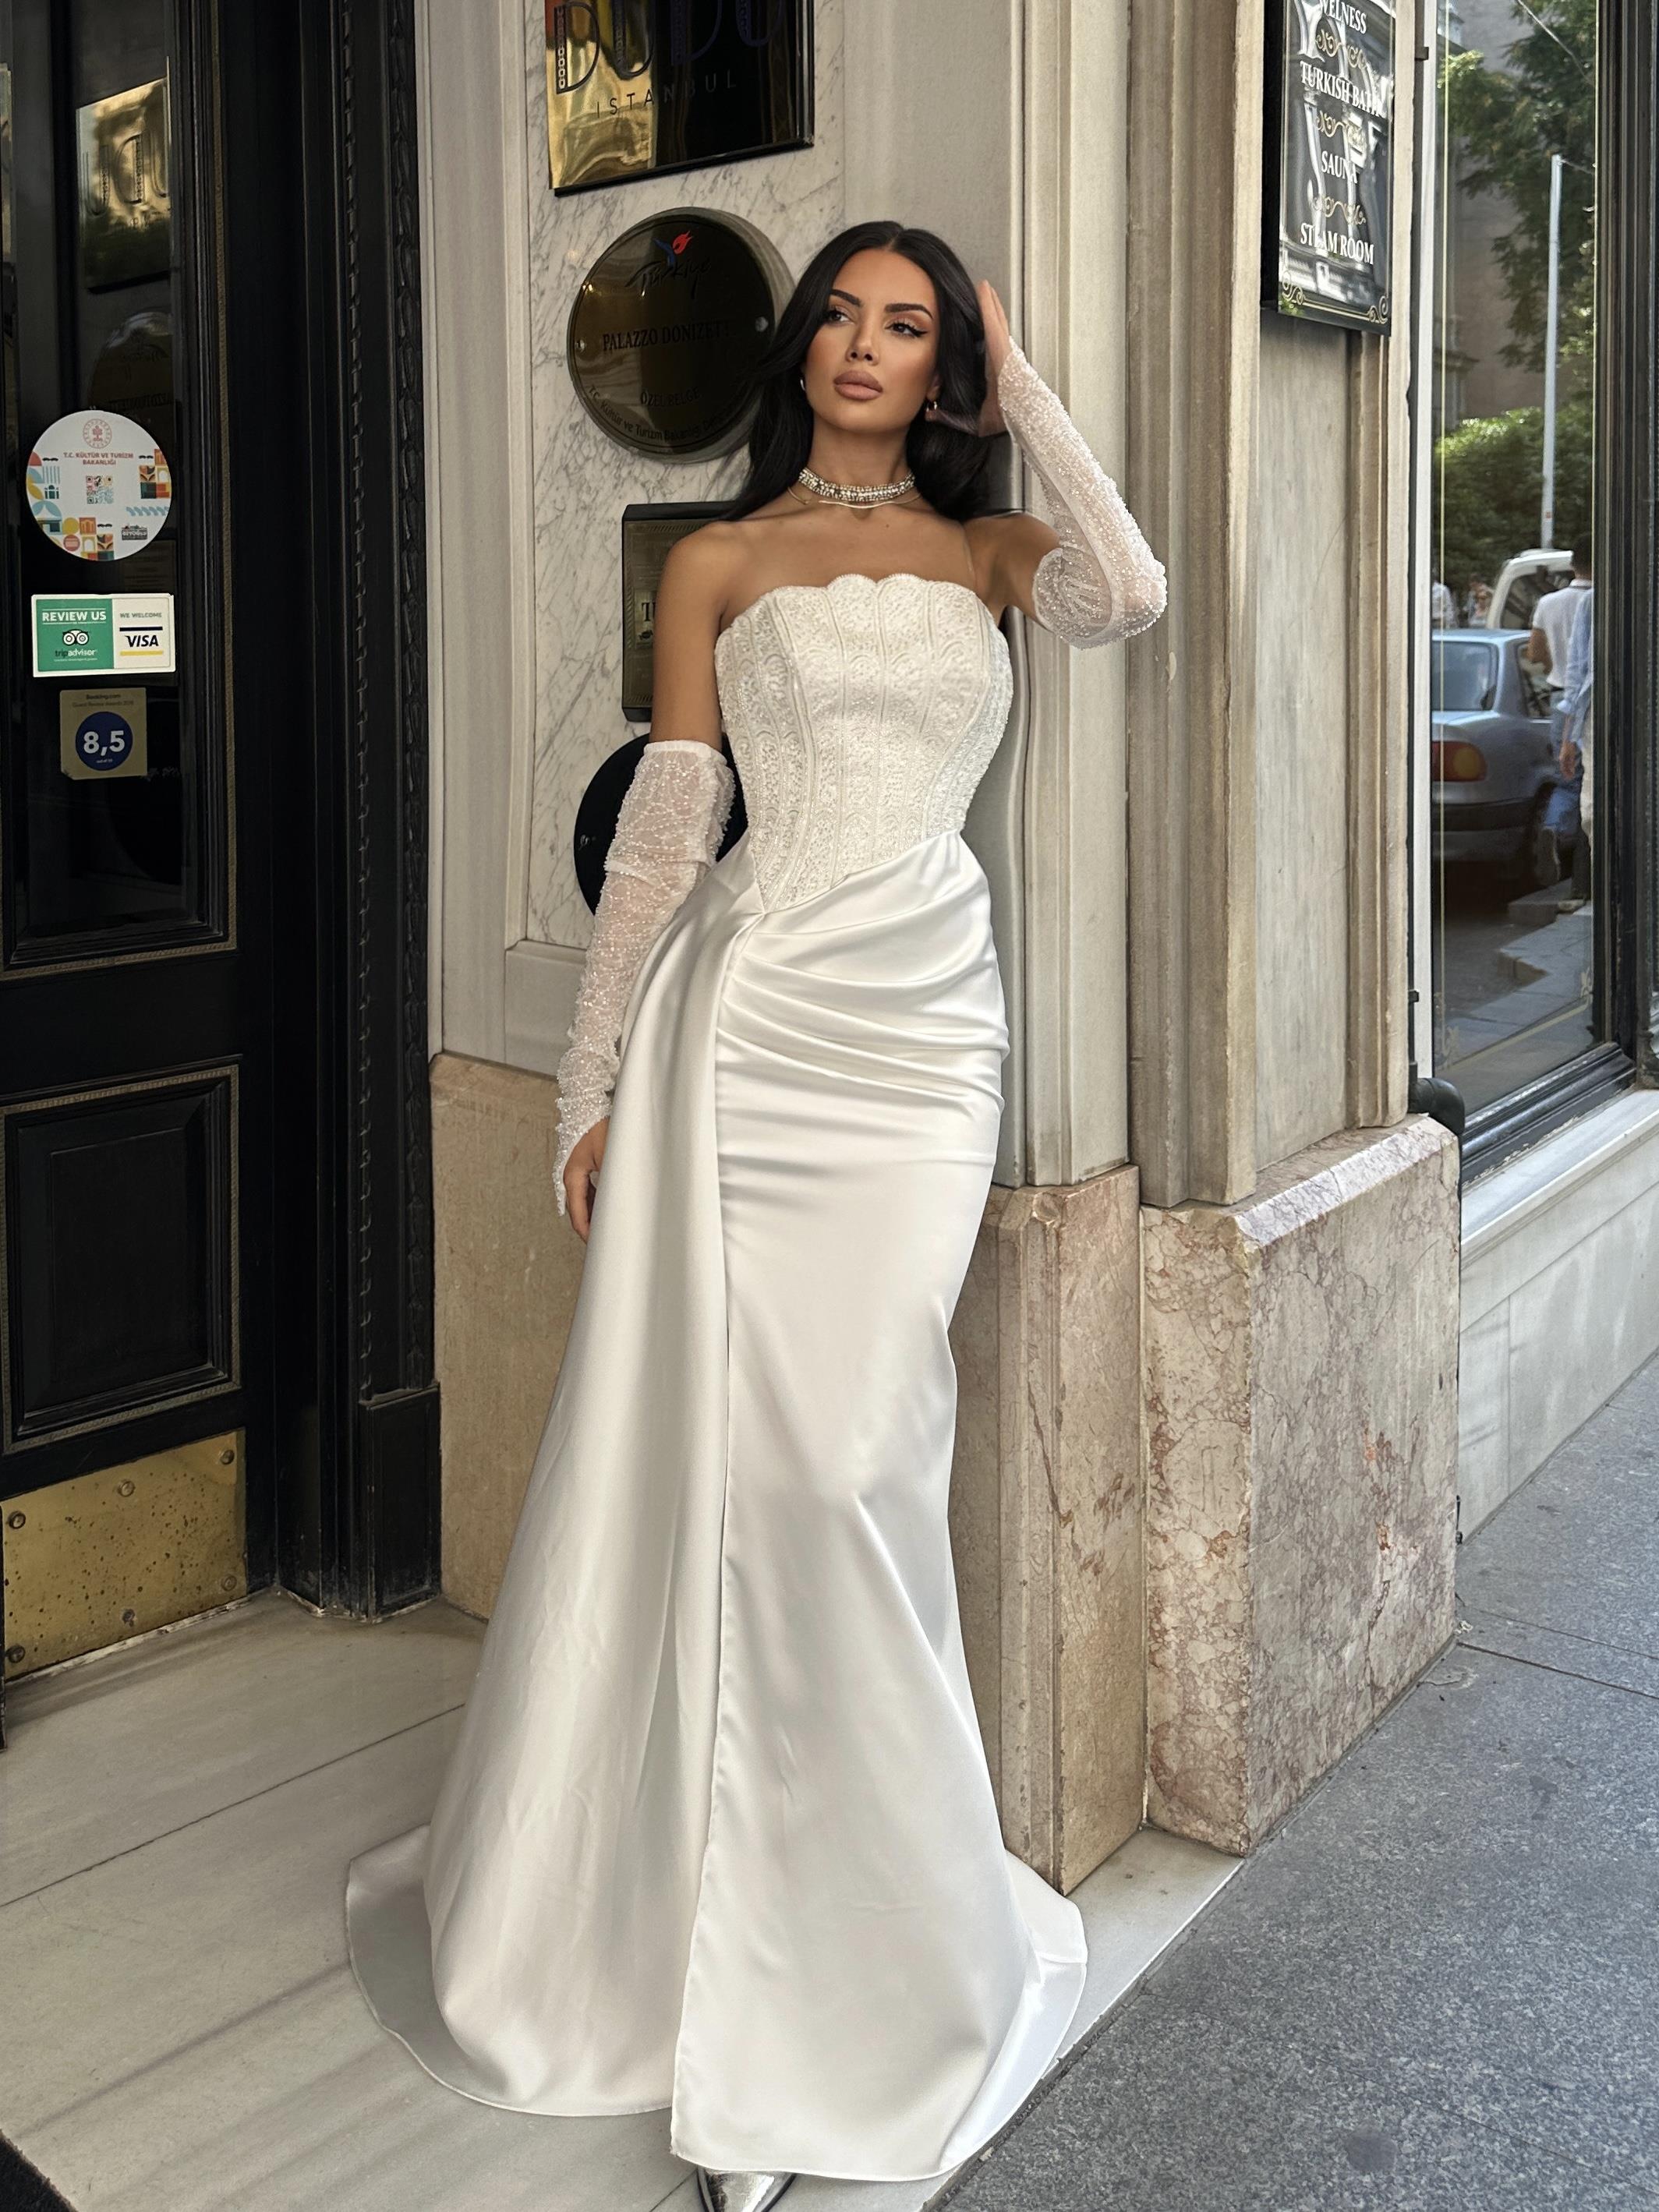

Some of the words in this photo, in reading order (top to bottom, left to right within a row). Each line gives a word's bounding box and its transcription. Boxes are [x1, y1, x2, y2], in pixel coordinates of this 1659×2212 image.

[596, 69, 737, 118] ISTANBUL
[1300, 61, 1349, 104] TURKISH
[1321, 150, 1357, 184] SAUNA
[1340, 234, 1374, 265] ROOM
[602, 327, 658, 352] PALAZZO
[42, 611, 88, 622] REVIEW
[90, 610, 107, 621] US
[55, 648, 96, 659] tripadvisor
[126, 634, 159, 648] VISA
[83, 730, 126, 756] 8,5
